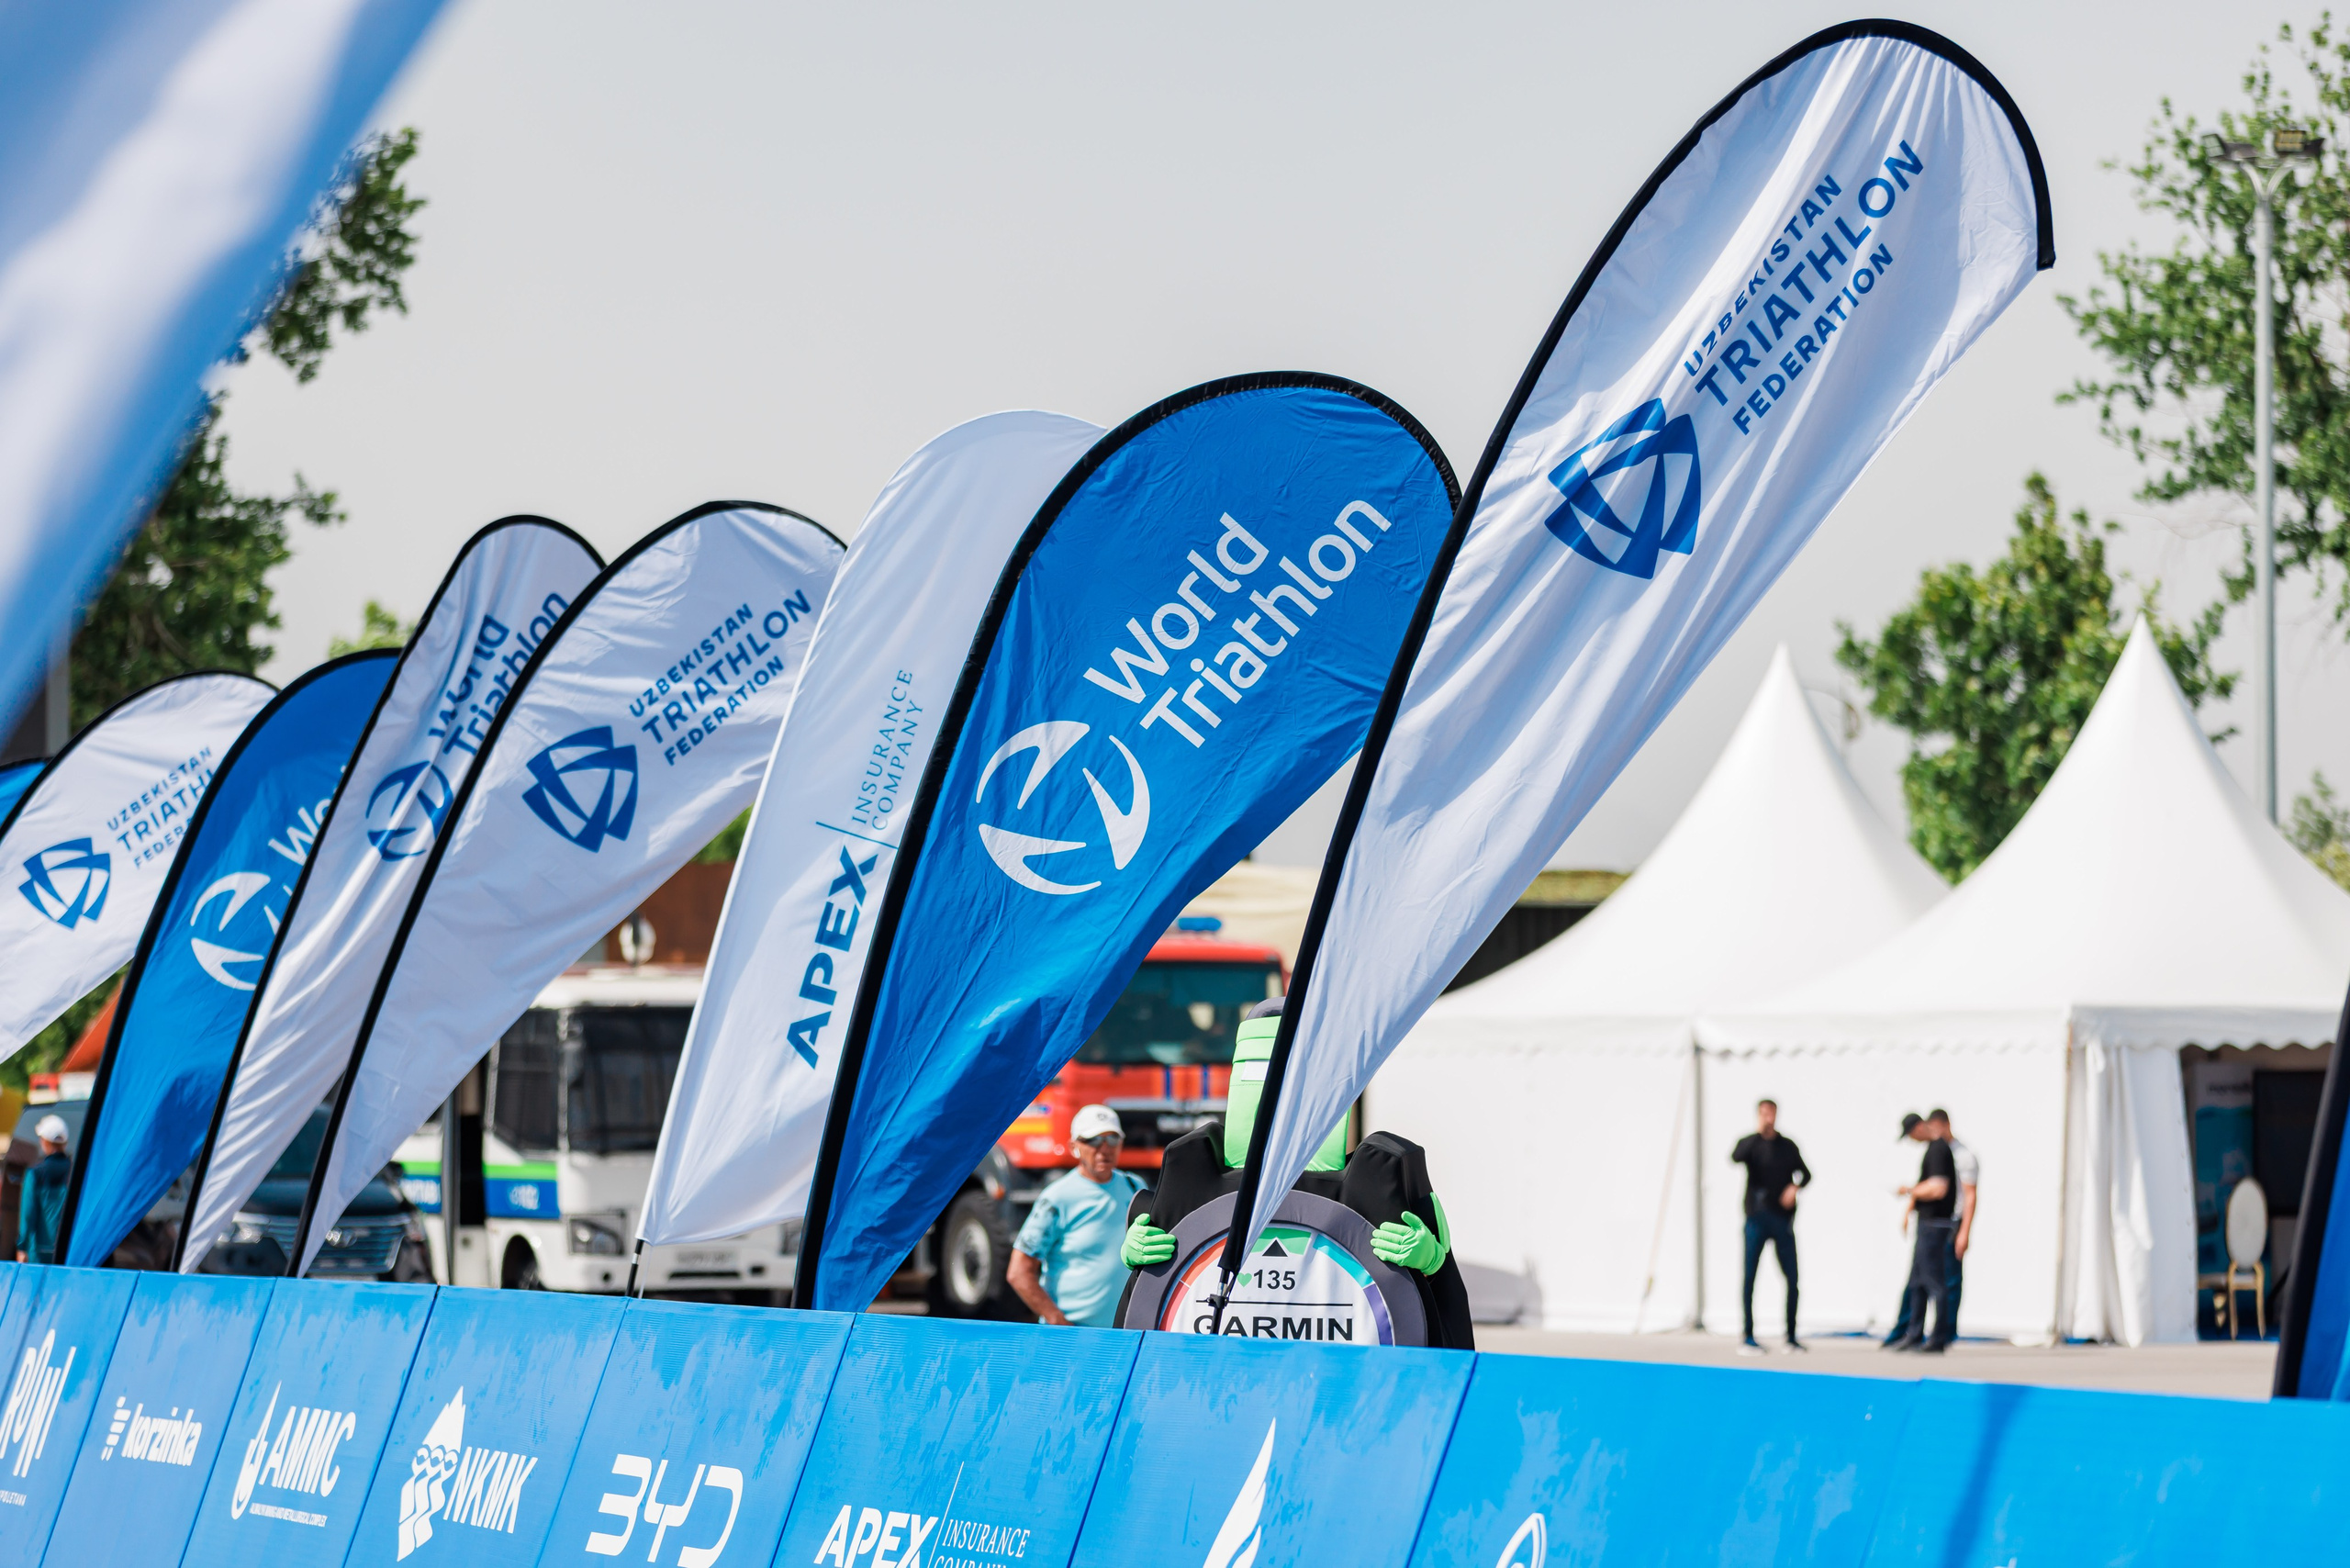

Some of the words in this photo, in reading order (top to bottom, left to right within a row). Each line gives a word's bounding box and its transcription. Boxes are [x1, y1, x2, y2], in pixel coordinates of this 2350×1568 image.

[1684, 174, 1842, 377] UZBEKISTAN
[1695, 140, 1923, 407] TRIATHLON
[1732, 242, 1894, 435] FEDERATION
[629, 603, 753, 717] UZBEKISTAN
[1082, 511, 1270, 704] World
[1139, 499, 1392, 748] Triathlon
[442, 592, 570, 755] Triathlon
[642, 589, 811, 744] TRIATHLON
[664, 655, 784, 766] FEDERATION
[107, 746, 212, 830] UZBEKISTAN
[852, 669, 912, 824] INSURANCE
[872, 700, 923, 831] COMPANY
[117, 768, 214, 851] TRIATH
[133, 817, 192, 869] FEDER
[787, 845, 878, 1069] APEX
[1193, 1315, 1353, 1340] GARMIN
[1253, 1269, 1296, 1290] 135
[121, 1403, 202, 1466] korzinka
[258, 1406, 356, 1497] AMMC
[442, 1446, 538, 1534] NKMK
[585, 1453, 744, 1568] BYD
[813, 1504, 939, 1568] APEX
[942, 1518, 1030, 1558] INSURANCE
